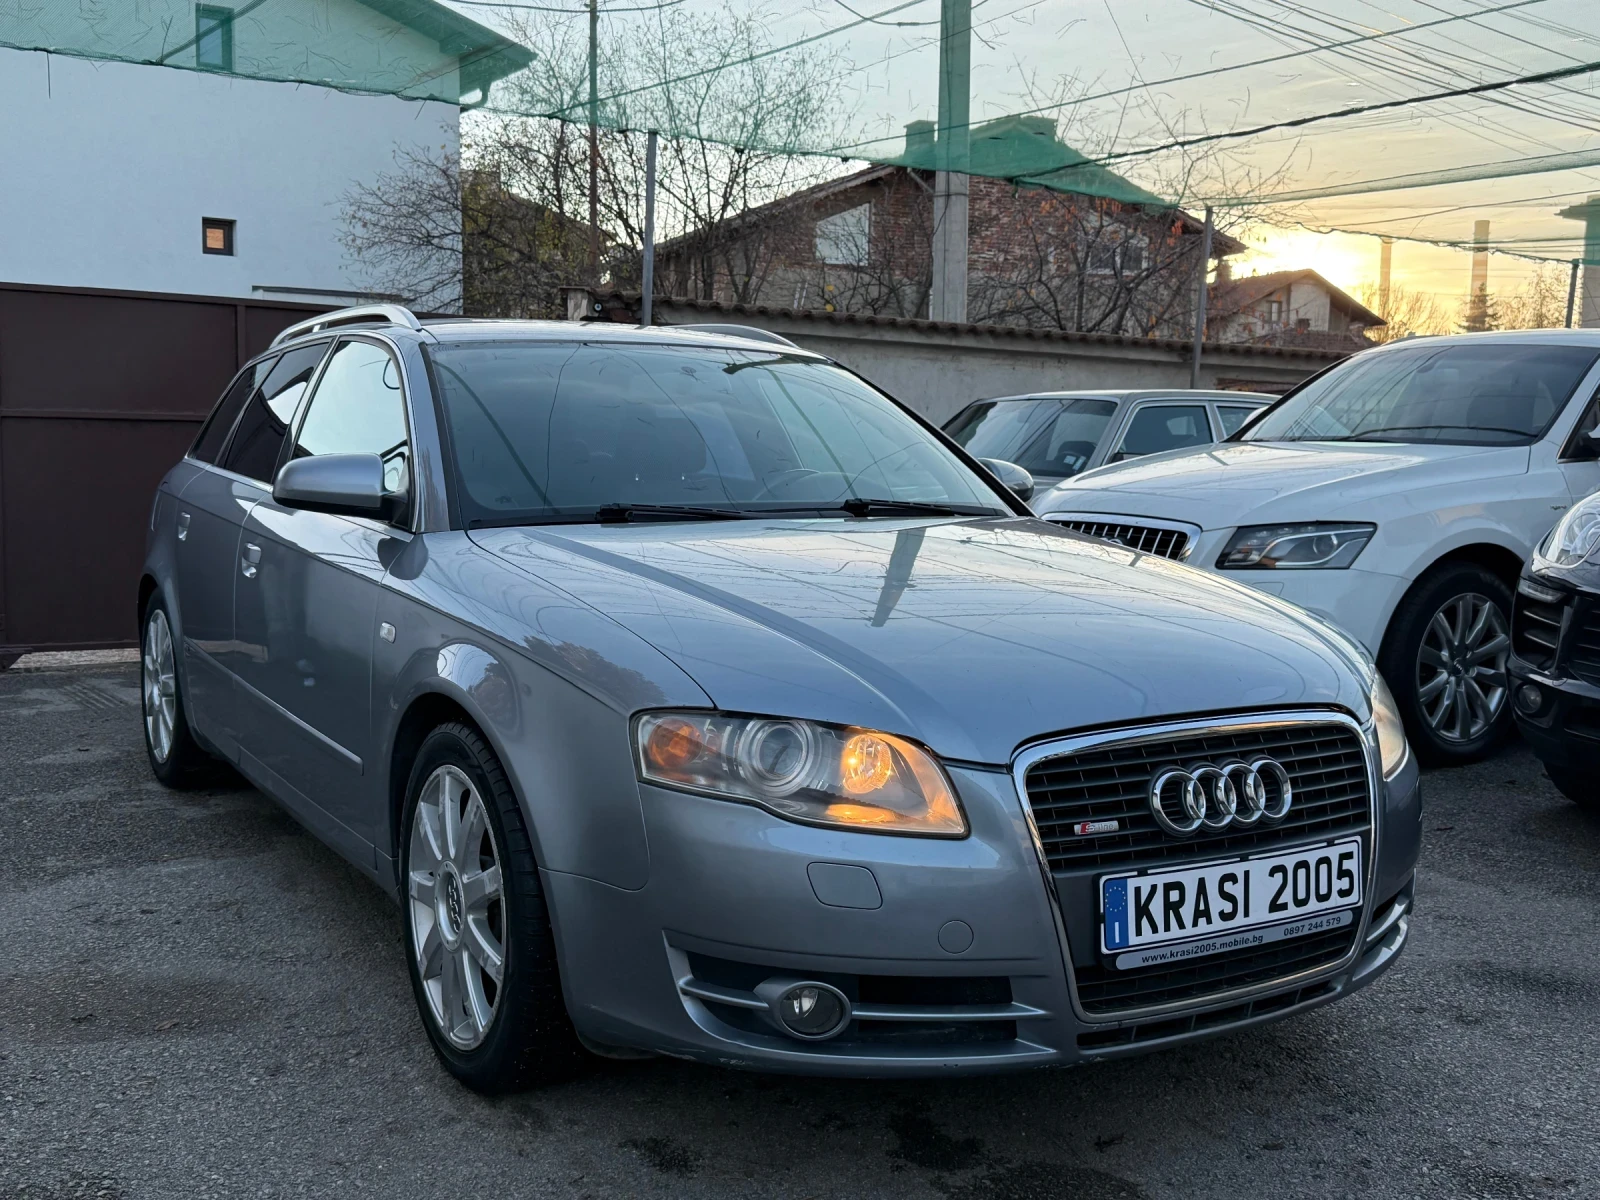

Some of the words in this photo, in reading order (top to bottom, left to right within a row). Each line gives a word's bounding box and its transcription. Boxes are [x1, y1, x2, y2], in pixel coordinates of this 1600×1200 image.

[1134, 869, 1250, 937] KRASI
[1268, 851, 1355, 914] 2005
[1141, 934, 1264, 963] www.krasi2005.mobile.bg
[1283, 925, 1306, 936] 0897
[1308, 920, 1324, 931] 244
[1325, 916, 1341, 927] 579
